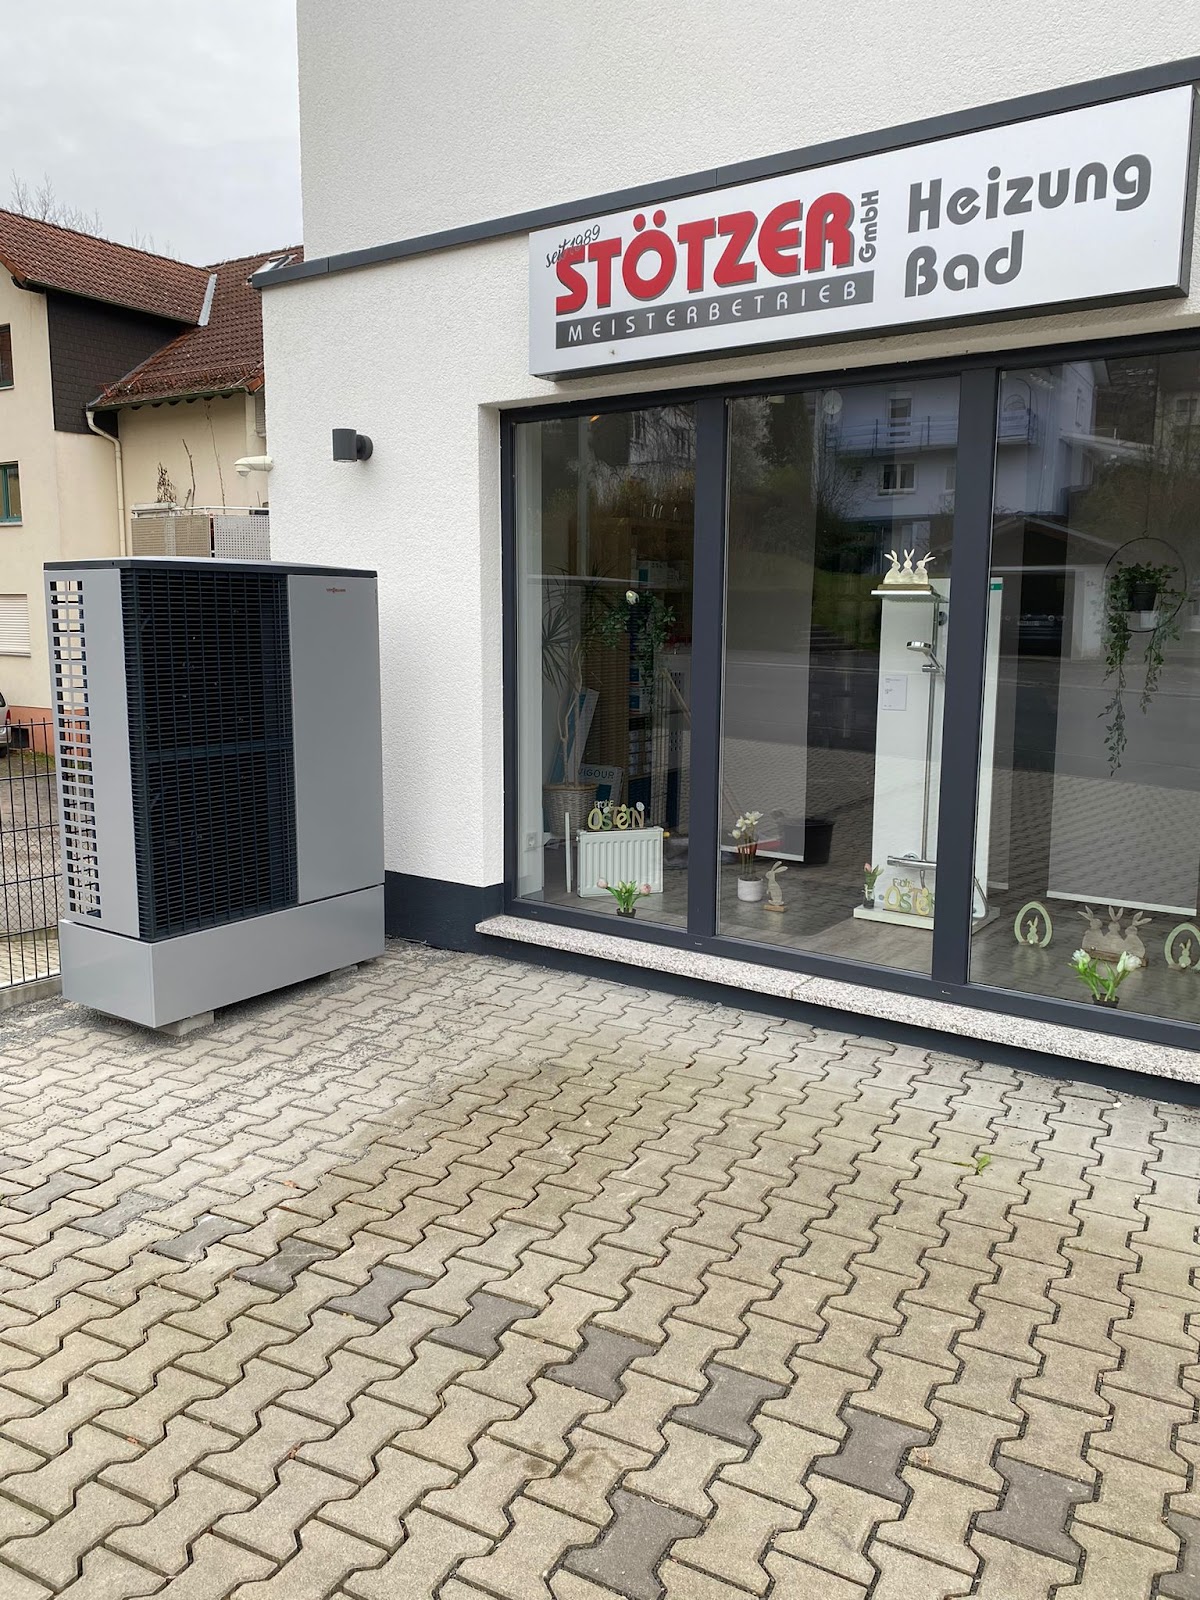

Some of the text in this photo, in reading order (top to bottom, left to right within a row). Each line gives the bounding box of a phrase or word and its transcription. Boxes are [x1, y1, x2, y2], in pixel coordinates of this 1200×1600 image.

[858, 189, 880, 263] GmbH
[907, 154, 1152, 233] Heizung
[545, 224, 601, 268] seit 1989
[555, 192, 856, 317] STÖTZER
[904, 230, 1024, 299] Bad
[567, 280, 858, 343] MEISTERBETRIEB
